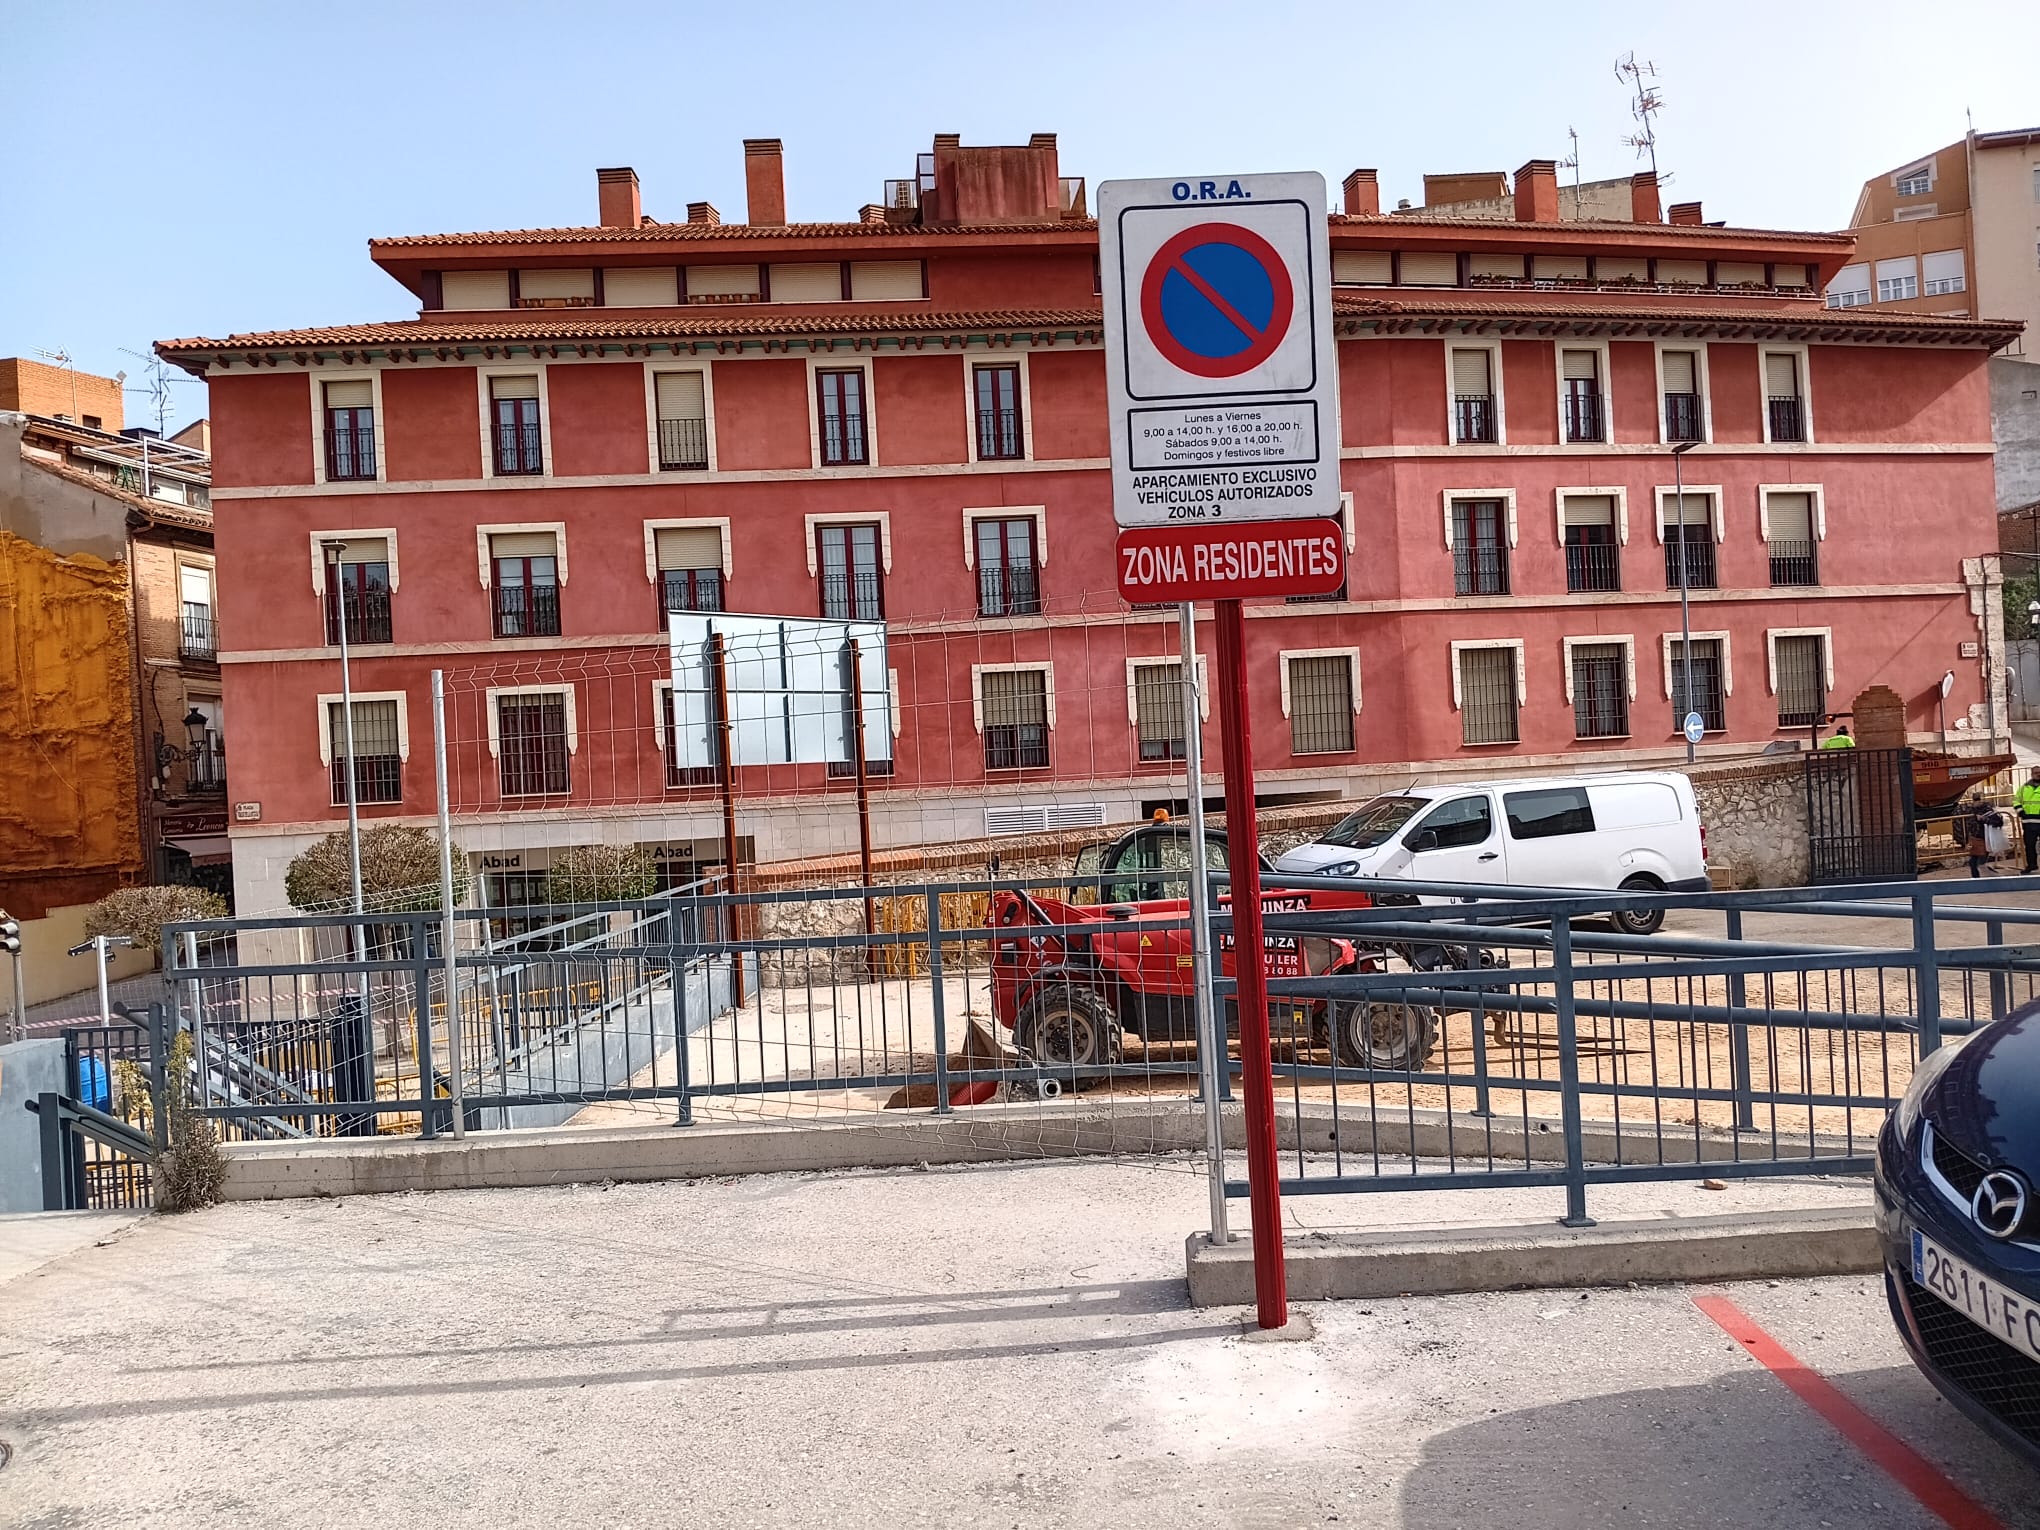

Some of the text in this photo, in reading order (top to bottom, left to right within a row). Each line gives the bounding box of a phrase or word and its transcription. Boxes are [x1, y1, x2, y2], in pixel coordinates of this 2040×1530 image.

[1171, 180, 1251, 201] O.R.A.
[1184, 413, 1214, 423] Lunes
[1225, 411, 1262, 421] Viernes
[1143, 428, 1165, 438] 9,00
[1177, 426, 1203, 436] 14,00
[1206, 425, 1215, 434] h.
[1217, 426, 1224, 436] y
[1227, 424, 1253, 433] 16,00
[1264, 422, 1291, 432] 20,00
[1293, 421, 1303, 430] h.
[1165, 437, 1209, 448] Sábados
[1211, 437, 1232, 447] 9,00
[1244, 435, 1270, 445] 14,00
[1273, 434, 1282, 443] h.
[1164, 446, 1285, 461] Domingos y festivos libre
[1132, 468, 1317, 489] APARCAMIENTO EXCLUSIVO
[1138, 484, 1313, 504] VEHÍCULOS AUTORIZADOS
[1168, 504, 1222, 519] ZONA 3
[1122, 536, 1338, 585] ZONA RESIDENTES
[653, 844, 693, 859] Abad
[479, 854, 520, 868] Abad
[1926, 1247, 1991, 1325] 2611
